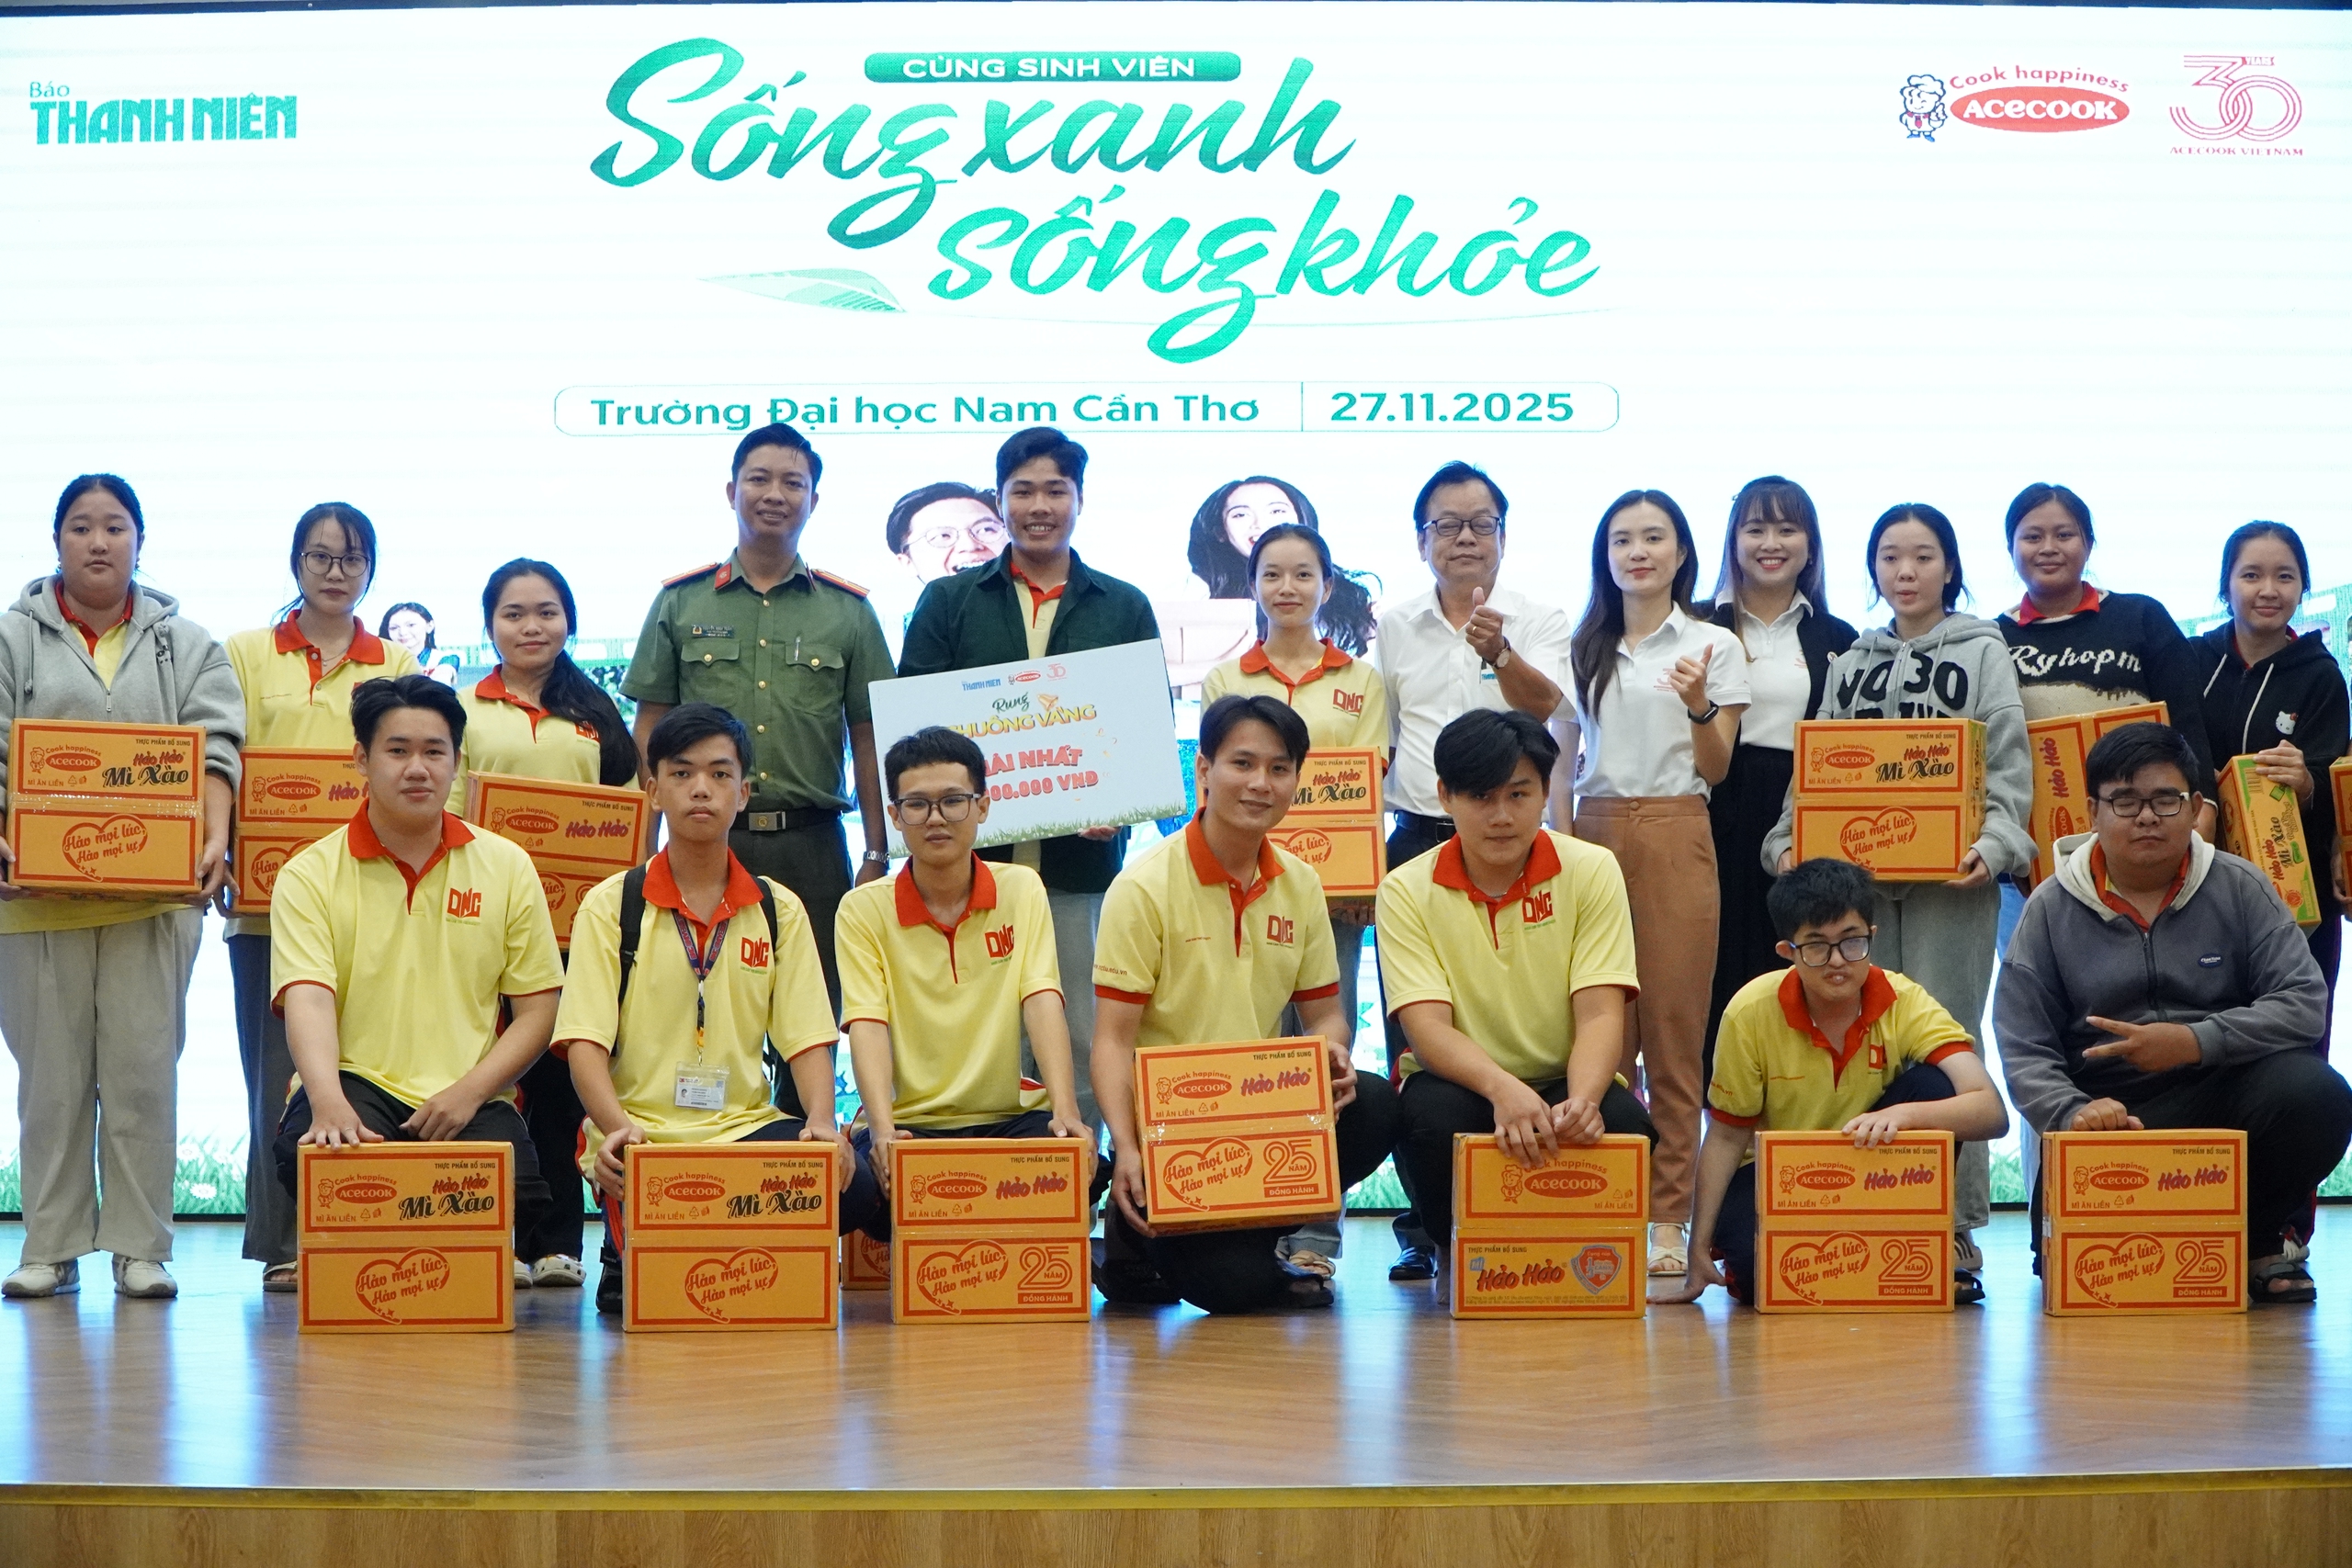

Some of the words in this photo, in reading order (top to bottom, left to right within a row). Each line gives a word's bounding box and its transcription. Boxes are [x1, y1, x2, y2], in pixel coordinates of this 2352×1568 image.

[902, 54, 1006, 78] CÙNG
[1017, 58, 1101, 77] SINH
[1110, 54, 1194, 77] VIÊN
[28, 80, 71, 98] Báo
[1950, 66, 2005, 89] Cook
[2016, 65, 2130, 93] happiness
[30, 99, 185, 144] THANH
[192, 93, 297, 141] NIÊN
[590, 36, 958, 250] Sống
[961, 57, 1357, 176] xanh
[2170, 147, 2236, 155] ACECOOK
[927, 184, 1276, 364] sống
[1276, 189, 1600, 298] khỏe
[591, 394, 751, 432] Trường
[768, 397, 838, 431] Đại
[855, 395, 937, 431] học
[955, 396, 1057, 423] Nam
[1072, 393, 1159, 423] Cần
[1174, 394, 1259, 423] Thơ
[1330, 391, 1575, 423] 27.11.2025
[992, 692, 1030, 713] Rung
[1036, 704, 1097, 728] VÀNG
[46, 745, 63, 754] Cook
[66, 745, 101, 756] happiness
[133, 750, 156, 766] Hảo
[160, 750, 183, 765] Hảo
[1019, 745, 1083, 770] NHẤT
[1904, 745, 1926, 761] Hảo
[1928, 741, 1951, 758] Hảo
[2040, 737, 2061, 767] Hảo
[102, 766, 136, 788] Mì
[139, 764, 189, 786] Xào
[266, 774, 284, 783] Cook
[286, 773, 321, 784] happiness
[1057, 771, 1098, 791] VNĐ
[1312, 772, 1336, 787] Hảo
[1338, 768, 1361, 783] Hảo
[1875, 762, 1906, 784] Mì
[1908, 759, 1955, 780] Xào
[2048, 769, 2069, 798] Hảo
[328, 782, 359, 802] Hảo
[1318, 783, 1367, 805] Xào
[526, 807, 560, 820] happiness
[64, 835, 90, 852] Hảo
[96, 827, 119, 845] mọi
[565, 818, 595, 839] Hảo
[598, 818, 629, 838] Hảo
[77, 850, 98, 863] Hảo
[103, 843, 122, 859] mọi
[447, 887, 481, 919] DNC
[1522, 890, 1553, 922] DNC
[741, 937, 769, 967] DNC
[1172, 1072, 1191, 1083] Cook
[1193, 1070, 1231, 1079] happiness
[1240, 1073, 1274, 1096] Hảo
[1277, 1066, 1311, 1089] Hảo
[1165, 1165, 1193, 1183] Hảo
[1197, 1154, 1223, 1172] mọi
[1263, 1138, 1317, 1184] 25
[1288, 1163, 1307, 1172] NĂM
[1555, 1158, 1608, 1174] happiness
[1796, 1162, 1815, 1173] Cook
[1817, 1161, 1856, 1173] happiness
[2090, 1163, 2109, 1173] Cook
[2111, 1161, 2149, 1173] happiness
[334, 1175, 356, 1185] Cook
[357, 1174, 398, 1185] happiness
[433, 1177, 458, 1195] Hảo
[461, 1173, 489, 1190] Hảo
[664, 1173, 684, 1184] Cook
[685, 1172, 726, 1184] happiness
[761, 1175, 786, 1194] Hảo
[789, 1172, 817, 1190] Hảo
[927, 1170, 945, 1182] Cook
[949, 1170, 988, 1181] happiness
[996, 1177, 1031, 1201] Hảo
[1033, 1171, 1068, 1195] Hảo
[1180, 1179, 1203, 1194] Hảo
[1207, 1170, 1229, 1186] mọi
[1864, 1168, 1897, 1191] Hảo
[1901, 1164, 1935, 1186] Hảo
[2157, 1168, 2191, 1191] Hảo
[2194, 1164, 2227, 1187] Hảo
[1293, 1187, 1315, 1195] HÀNH
[399, 1196, 435, 1221] Mì
[438, 1191, 494, 1216] Xào
[727, 1194, 763, 1219] Mì
[766, 1190, 822, 1215] Xào
[1018, 1247, 1073, 1291] 25
[1878, 1239, 1933, 1282] 25
[1905, 1262, 1923, 1271] NĂM
[2173, 1240, 2227, 1284] 25
[2199, 1265, 2218, 1273] NĂM
[357, 1274, 387, 1292] Hảo
[392, 1264, 419, 1283] mọi
[1044, 1269, 1063, 1280] NĂM
[1476, 1265, 1520, 1292] Hảo
[1522, 1258, 1565, 1286] Hảo
[372, 1289, 397, 1304] Hảo
[401, 1280, 423, 1297] mọi
[1046, 1292, 1069, 1302] HÀNH
[1907, 1286, 1928, 1294] HÀNH
